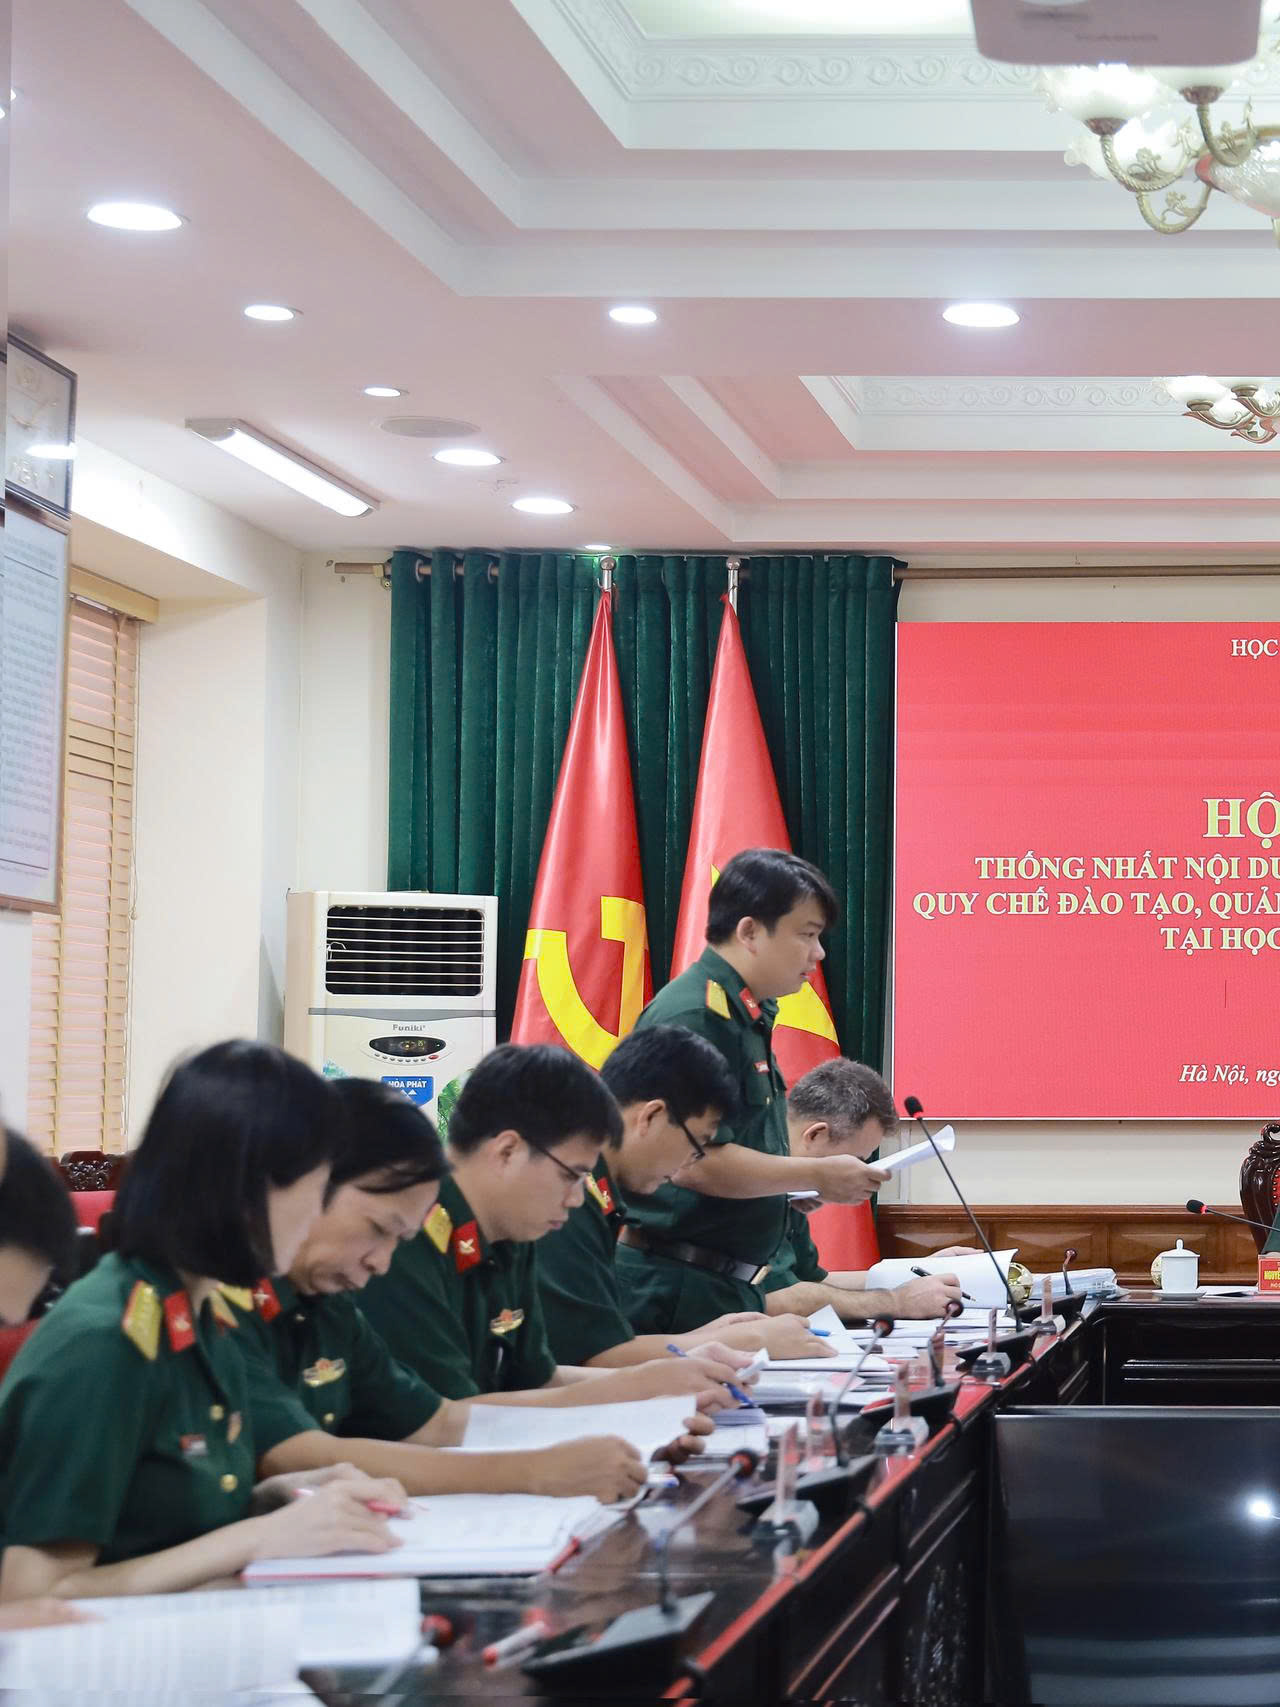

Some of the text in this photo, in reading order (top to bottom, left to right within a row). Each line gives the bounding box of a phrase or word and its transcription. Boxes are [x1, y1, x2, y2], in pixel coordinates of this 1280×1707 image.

[1231, 639, 1279, 660] HỌC
[975, 850, 1086, 880] THỐNG
[1091, 850, 1178, 880] NHẤT
[1183, 853, 1241, 885] NỘI
[912, 892, 980, 920] QUY
[986, 886, 1050, 915] CHẾ
[1057, 886, 1124, 915] ĐÀO
[1130, 892, 1202, 921] TẠO,
[1160, 927, 1214, 956] TẠI
[392, 1024, 423, 1032] Funiki
[406, 1078, 427, 1088] PHÁT
[1178, 1064, 1208, 1082] Hà
[1212, 1064, 1250, 1085] Nội,
